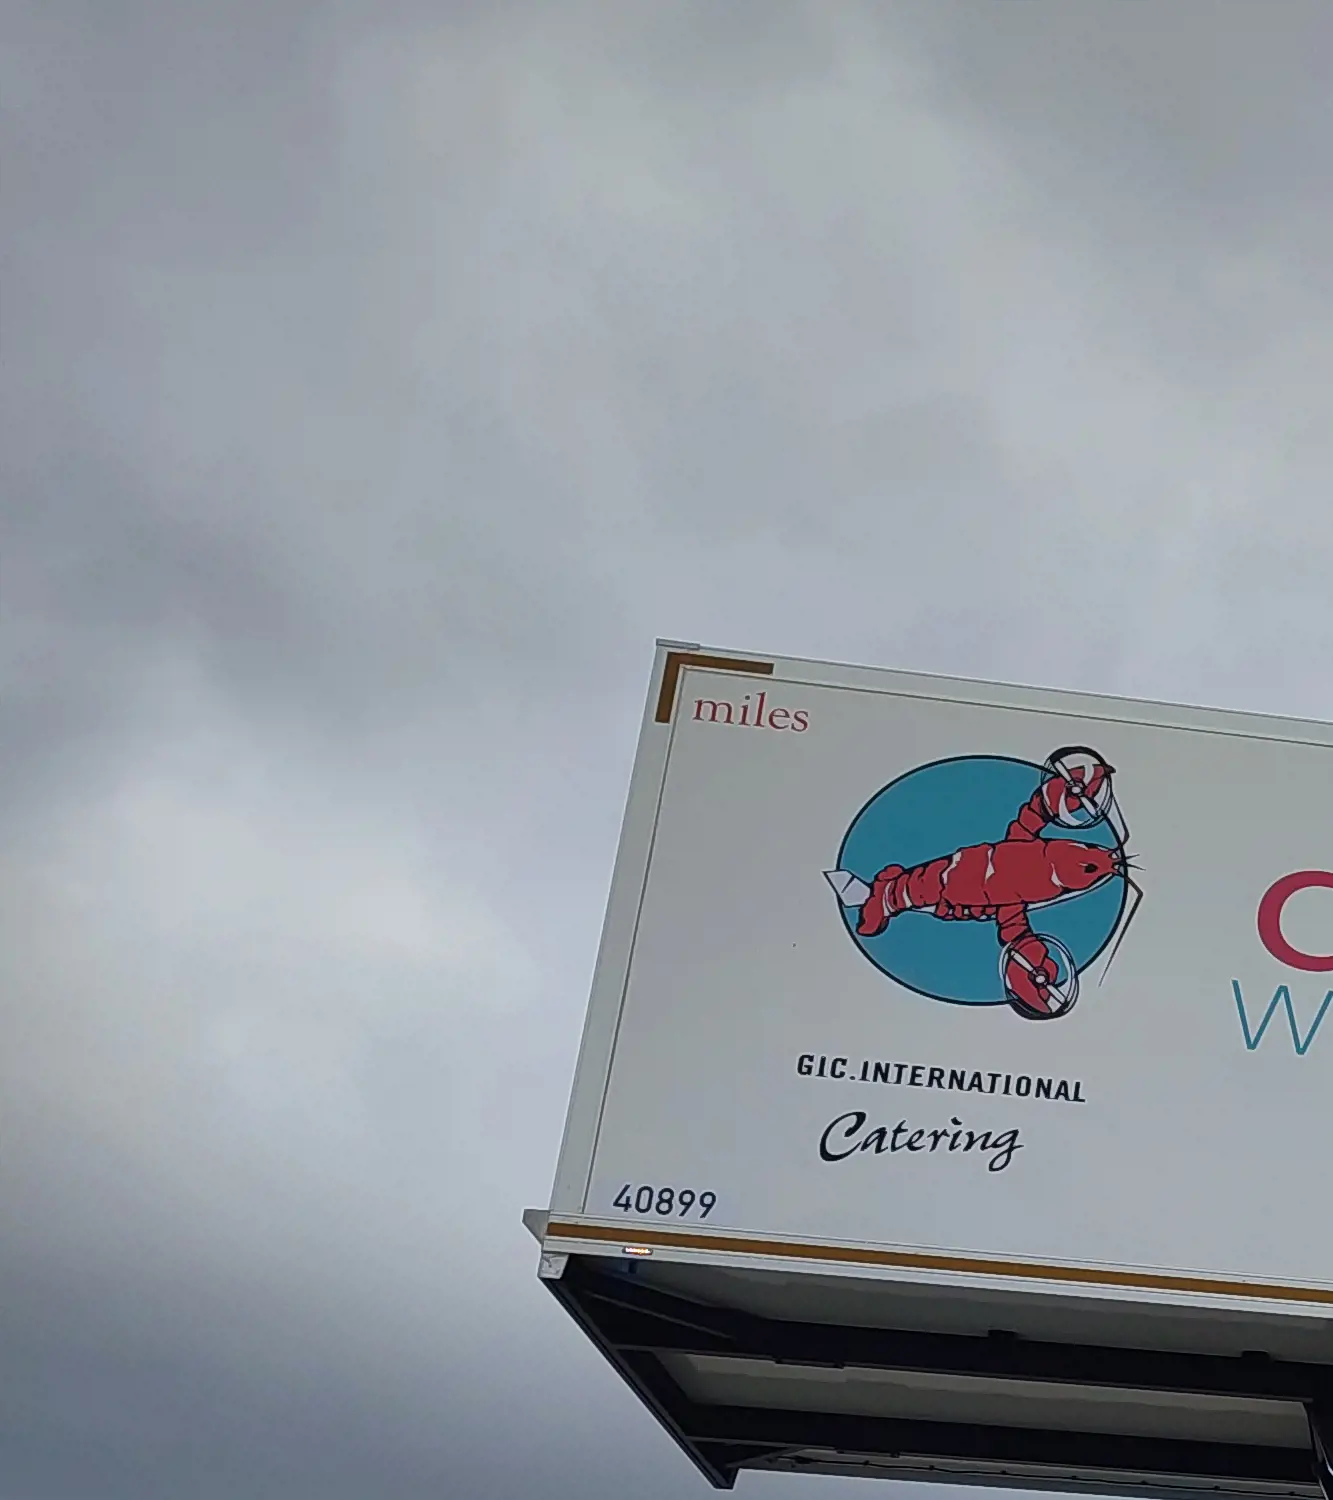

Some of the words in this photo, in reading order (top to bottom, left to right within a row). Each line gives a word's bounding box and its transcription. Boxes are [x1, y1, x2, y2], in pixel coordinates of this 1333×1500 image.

[693, 692, 810, 733] miles
[796, 1054, 1086, 1103] GIC.INTERNATIONAL
[818, 1110, 1025, 1171] Catering
[613, 1184, 717, 1218] 40899
